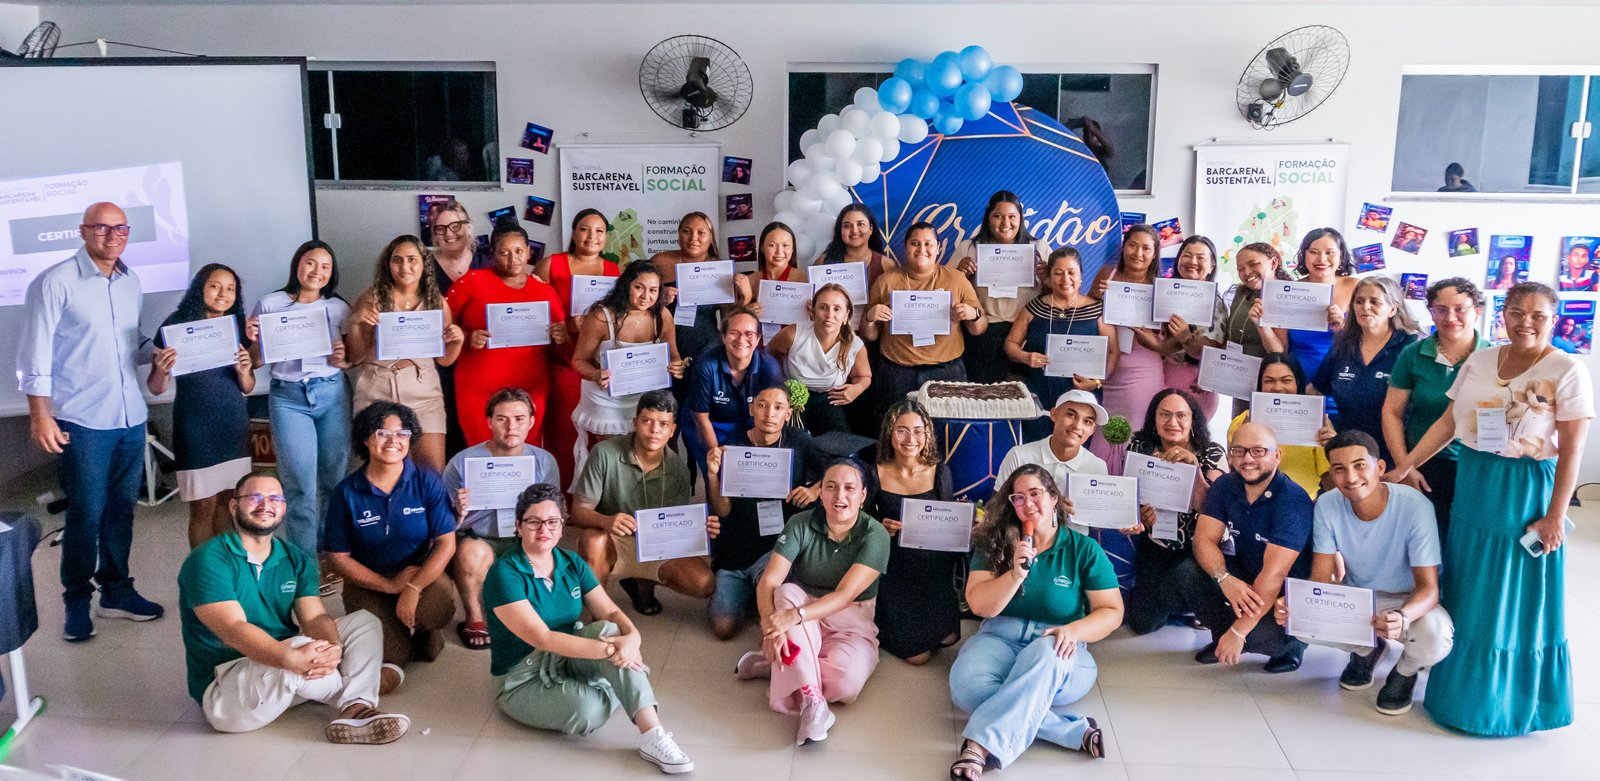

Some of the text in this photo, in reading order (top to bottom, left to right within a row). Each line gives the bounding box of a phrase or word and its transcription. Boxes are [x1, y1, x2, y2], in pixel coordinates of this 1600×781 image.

[1278, 158, 1336, 170] FORMAÇÃO
[646, 164, 706, 177] FORMAÇÃO
[1206, 168, 1265, 176] BARCARENA
[572, 172, 632, 181] BARCARENA
[1206, 174, 1272, 184] SUSTENTÁVEL
[1278, 172, 1335, 184] SOCIAL
[572, 180, 640, 191] SUSTENTÁVEL
[647, 178, 706, 192] SOCIAL
[38, 229, 82, 241] CERTIF
[647, 238, 668, 246] juntos
[821, 274, 854, 282] CERTIFICADO
[1118, 294, 1152, 302] CERTIFICADO
[1167, 290, 1203, 298] CERTIFICADO
[1276, 294, 1316, 302] CERTIFICADO
[275, 322, 315, 332] CERTIFICADO
[182, 332, 222, 344] CERTIFICADO
[621, 358, 657, 367] CERTIFICADO
[1213, 360, 1248, 373] CERTIFICADO
[1139, 469, 1180, 482] CERTIFICADO
[1083, 488, 1124, 497] CERTIFICADO
[917, 514, 958, 522] CERTIFICADO
[652, 520, 693, 529] CERTIFICADO
[1305, 597, 1355, 609] CERTIFICADO
